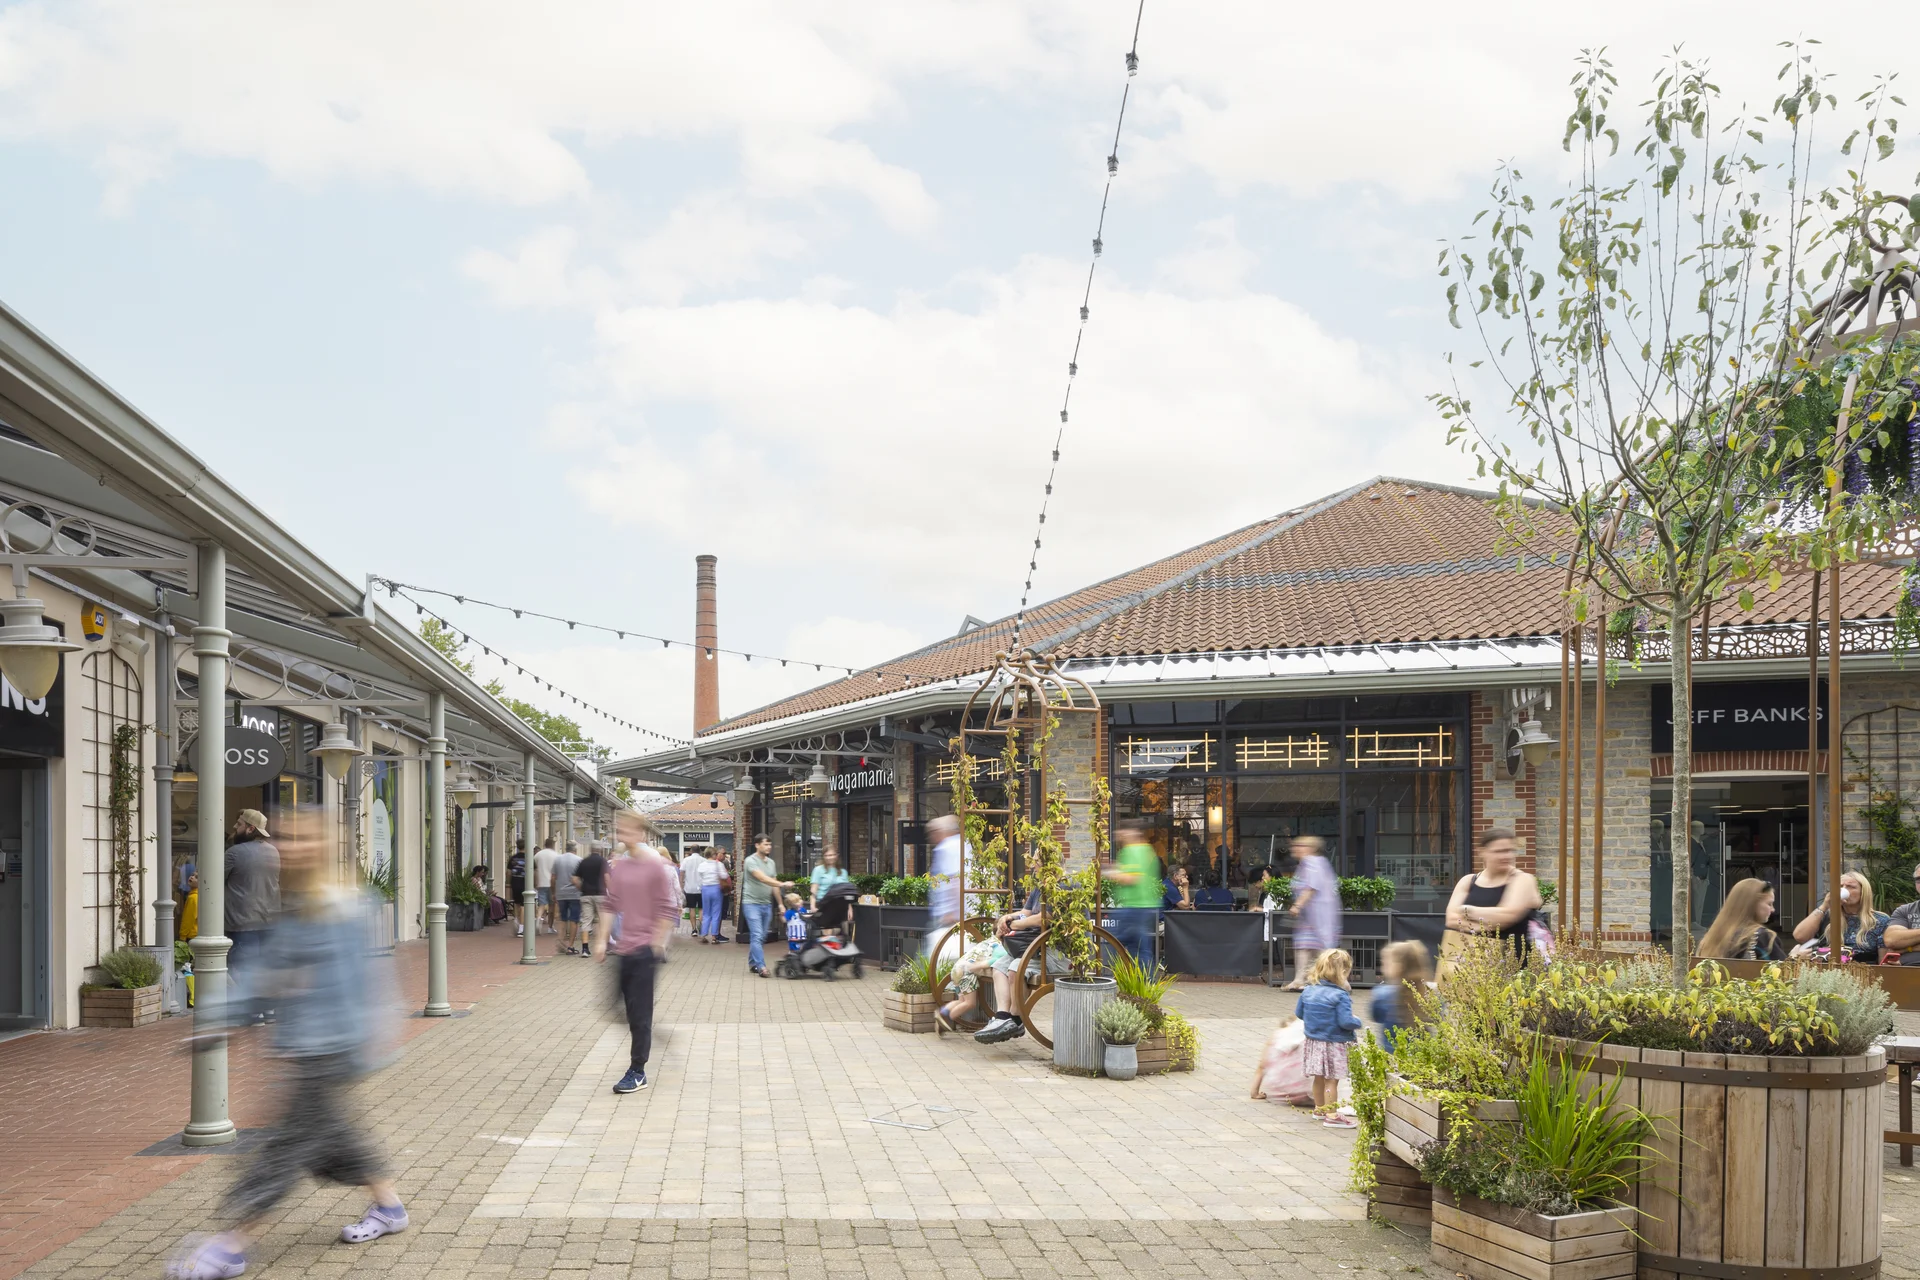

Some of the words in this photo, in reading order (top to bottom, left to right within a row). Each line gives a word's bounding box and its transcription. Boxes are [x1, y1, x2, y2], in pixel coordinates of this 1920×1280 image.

[1734, 706, 1824, 723] BANKS
[224, 748, 270, 766] OSS
[829, 767, 894, 795] wagamama
